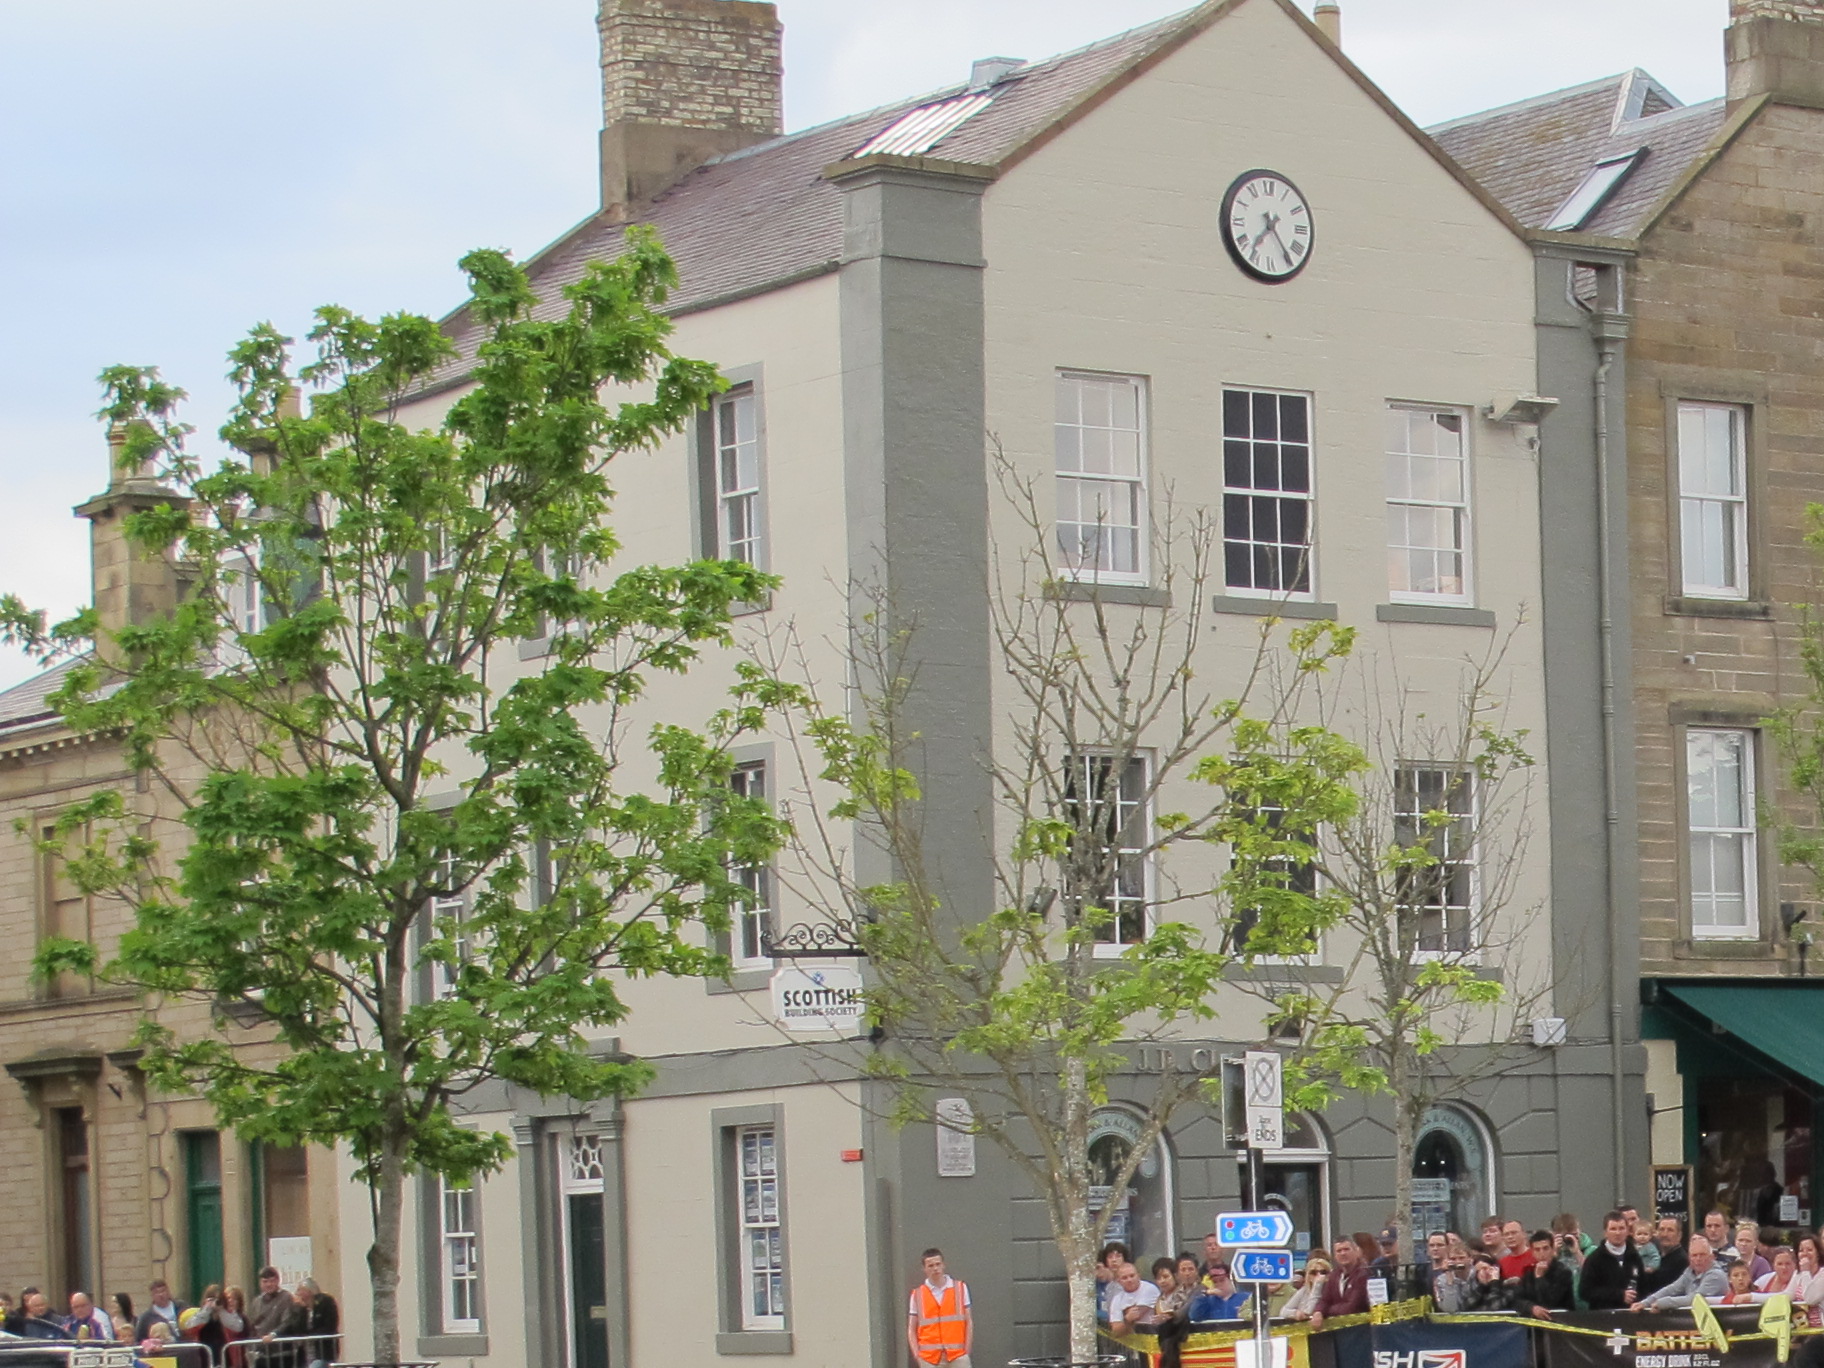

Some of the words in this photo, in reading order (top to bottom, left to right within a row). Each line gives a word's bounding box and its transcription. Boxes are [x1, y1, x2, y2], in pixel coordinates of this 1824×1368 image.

[783, 988, 857, 1007] SCOTTISH
[784, 1008, 823, 1017] BUILDING
[825, 1006, 857, 1016] SOCIETY
[1255, 1129, 1277, 1142] ENDS
[1657, 1174, 1685, 1189] NOW
[1656, 1189, 1683, 1203] OPEN
[1635, 1355, 1666, 1368] ENERGY
[1667, 1354, 1693, 1368] DRINK
